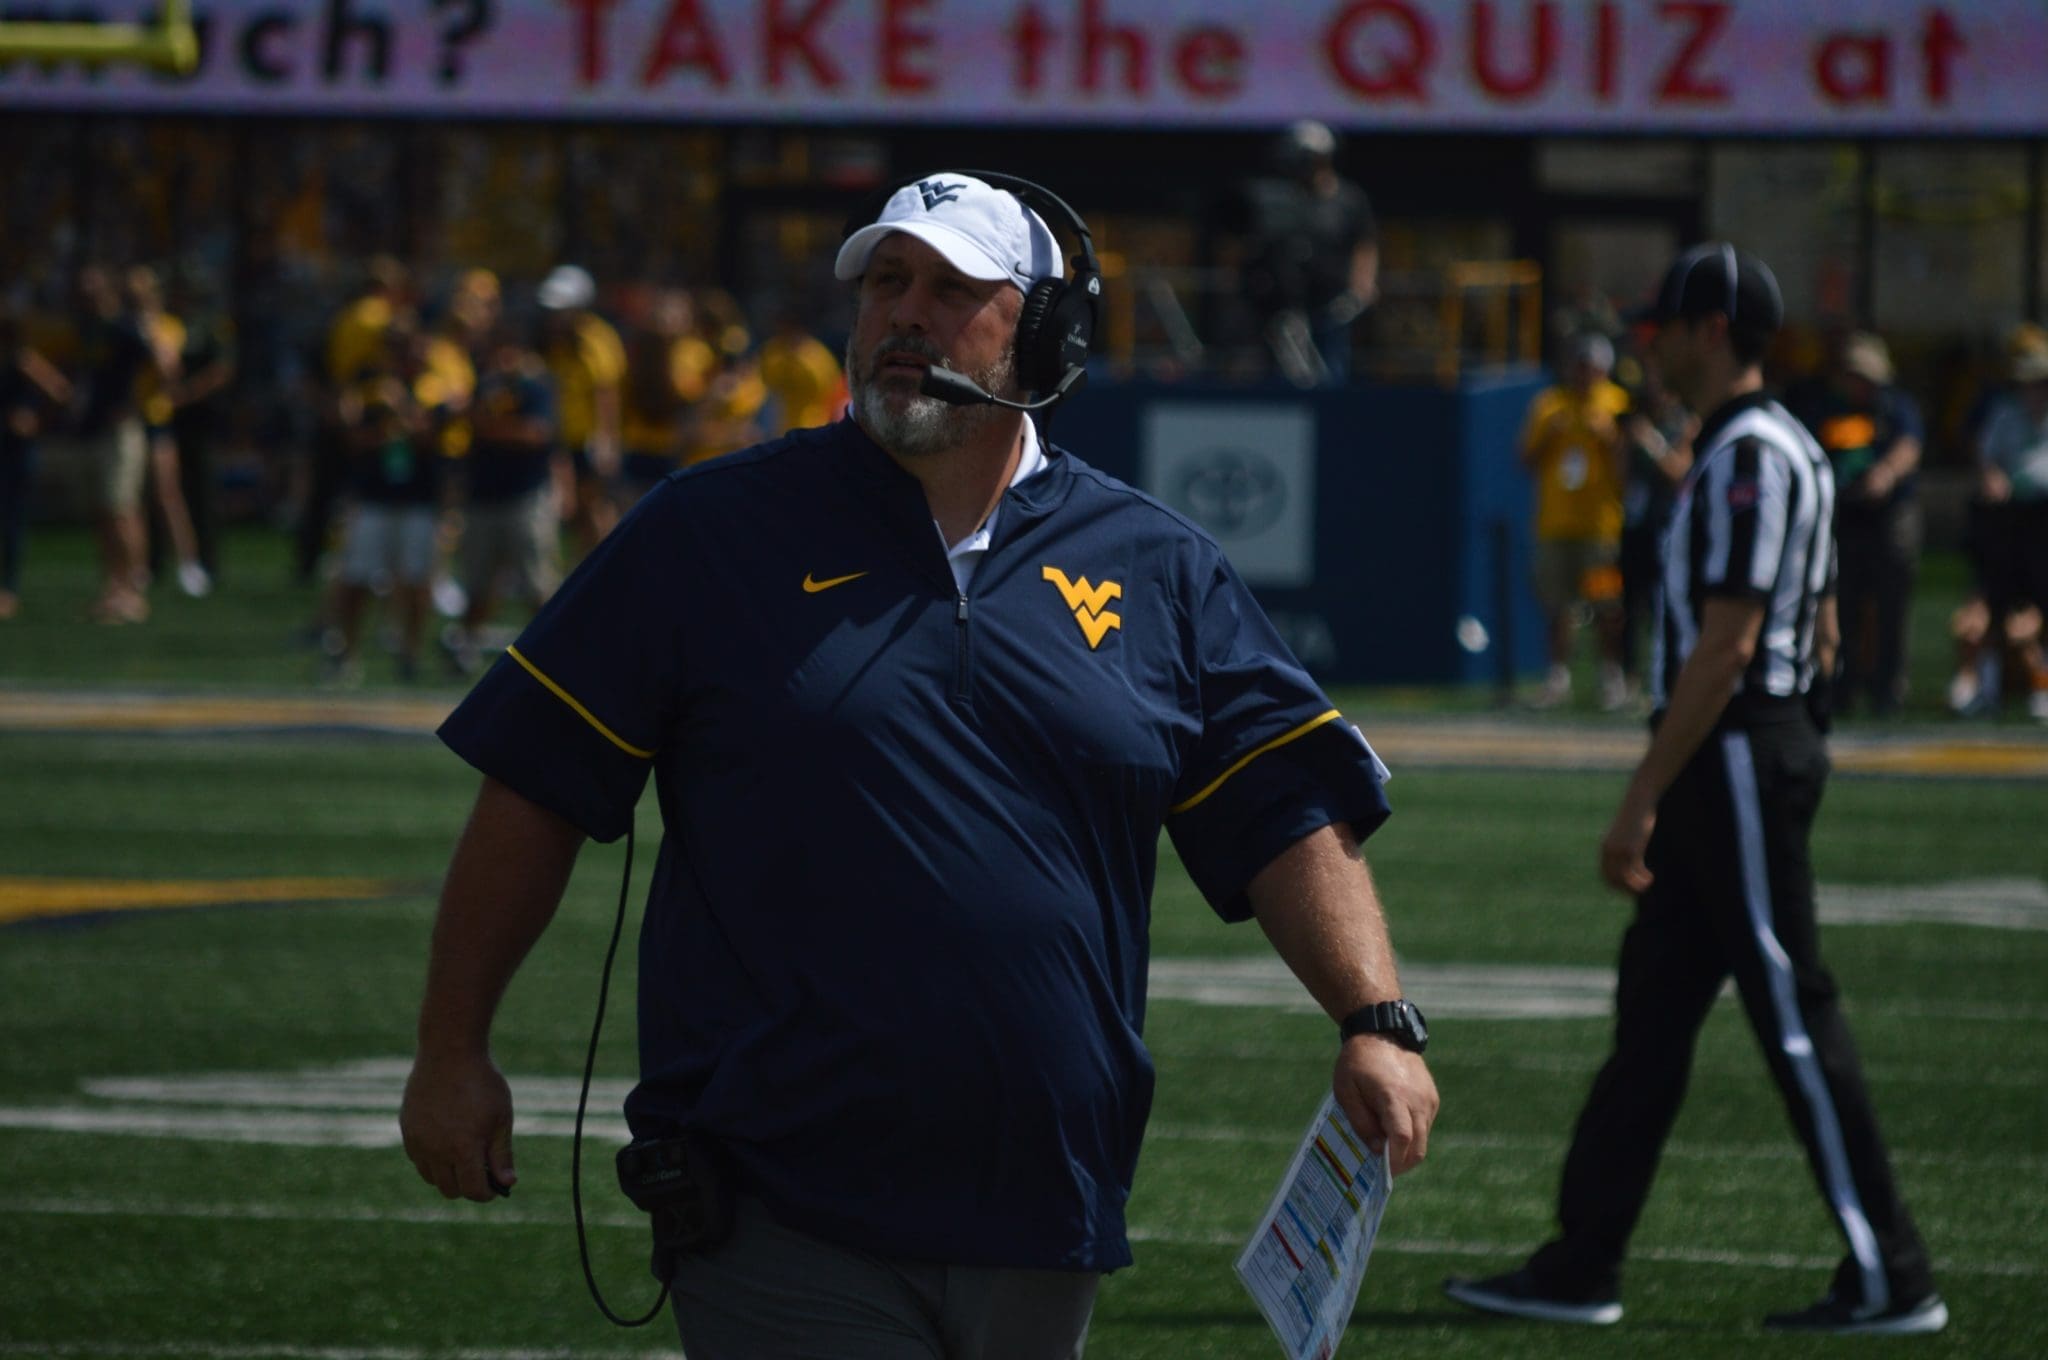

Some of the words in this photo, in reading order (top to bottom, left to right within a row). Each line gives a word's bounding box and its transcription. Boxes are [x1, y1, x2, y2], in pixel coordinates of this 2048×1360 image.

[0, 0, 491, 87] ch?
[562, 0, 936, 94] TAKE
[1007, 0, 1246, 98] the
[1325, 0, 1734, 105] QUIZ
[1813, 10, 1965, 105] at
